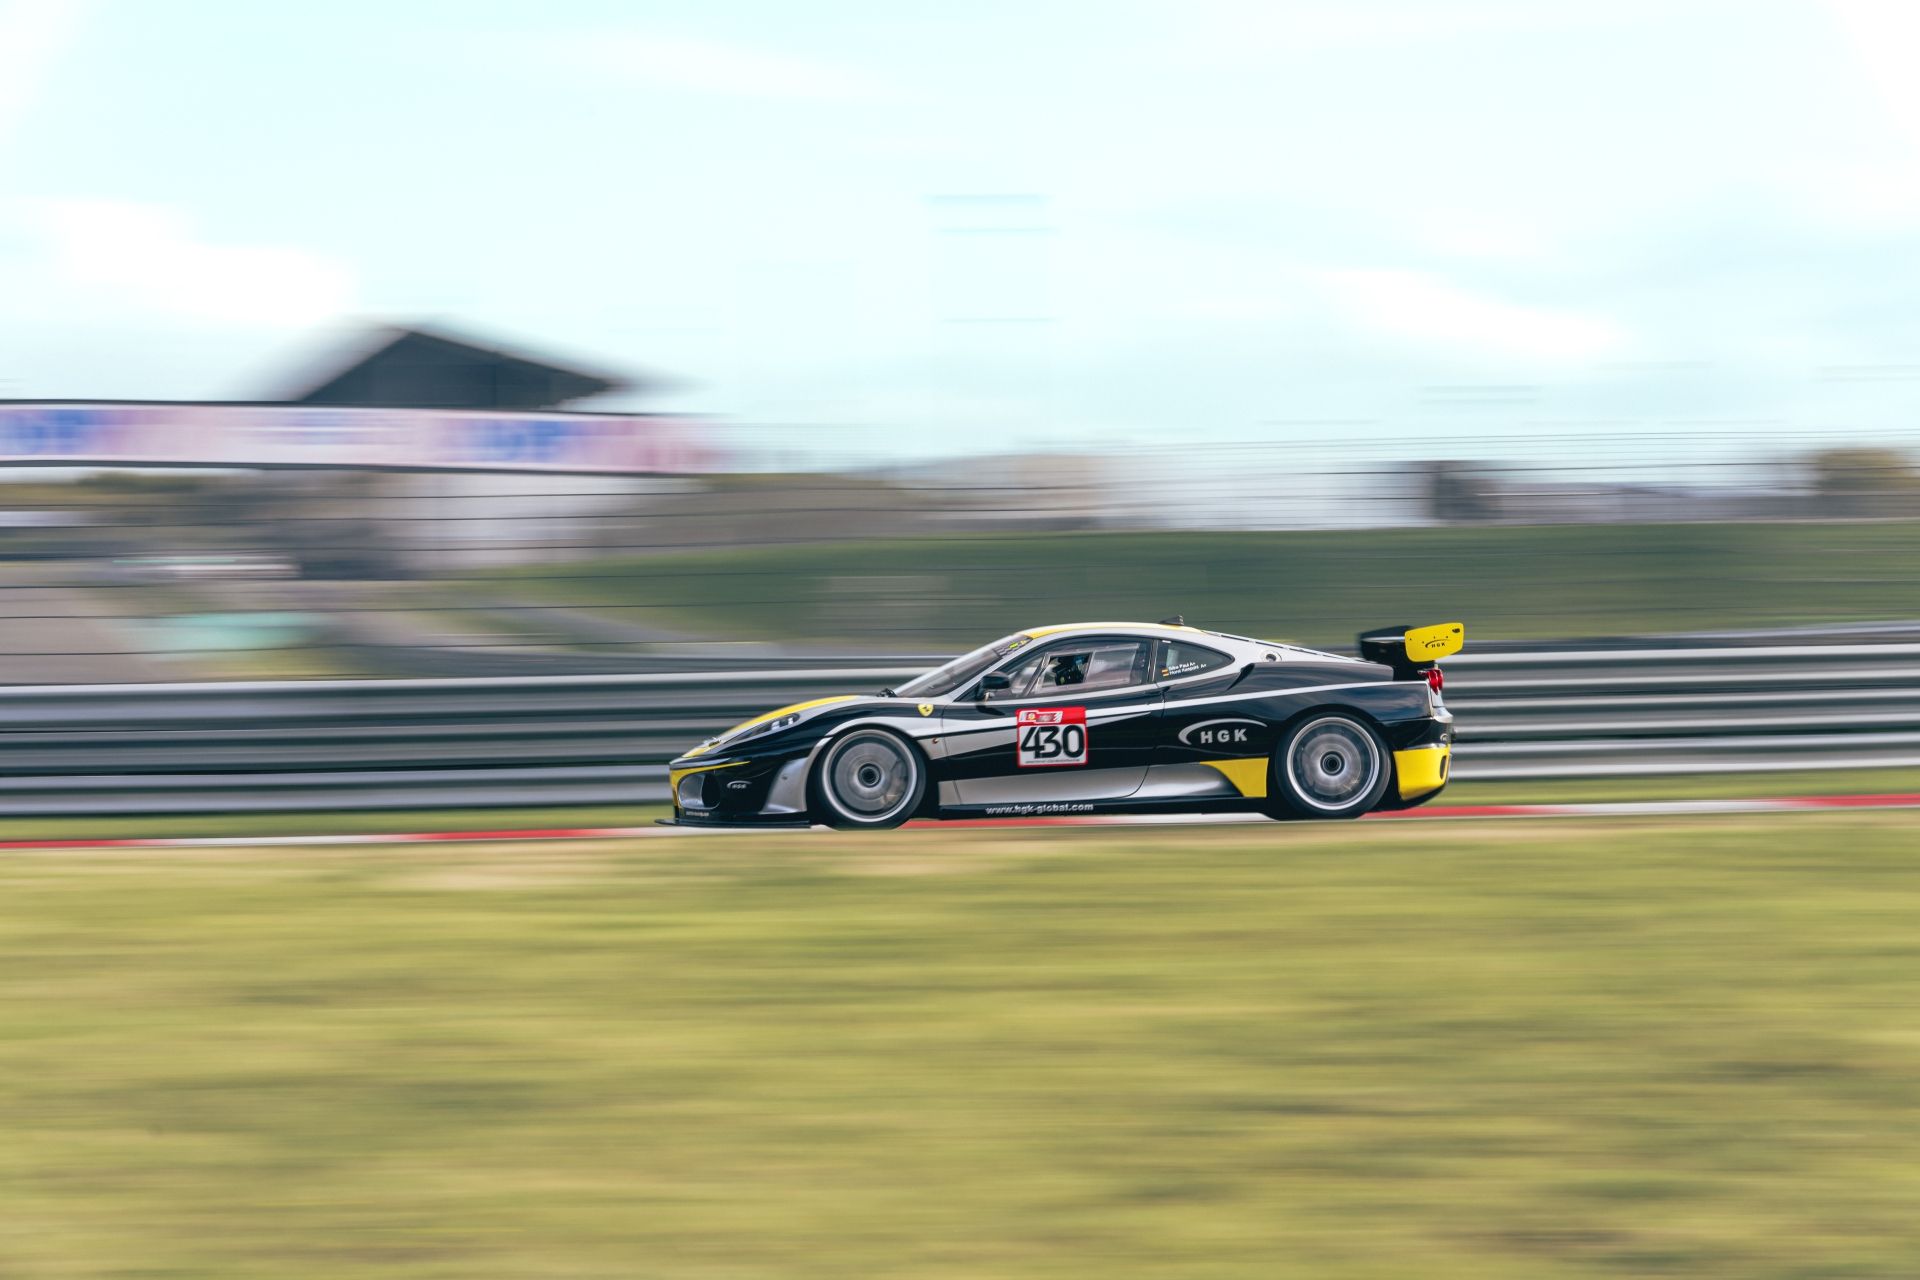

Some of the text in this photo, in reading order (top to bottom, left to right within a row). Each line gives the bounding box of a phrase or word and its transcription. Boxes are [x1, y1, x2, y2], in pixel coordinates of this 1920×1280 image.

[1020, 725, 1085, 759] 430
[1200, 728, 1248, 744] HGK
[985, 803, 1094, 815] www.hgk-global.com
